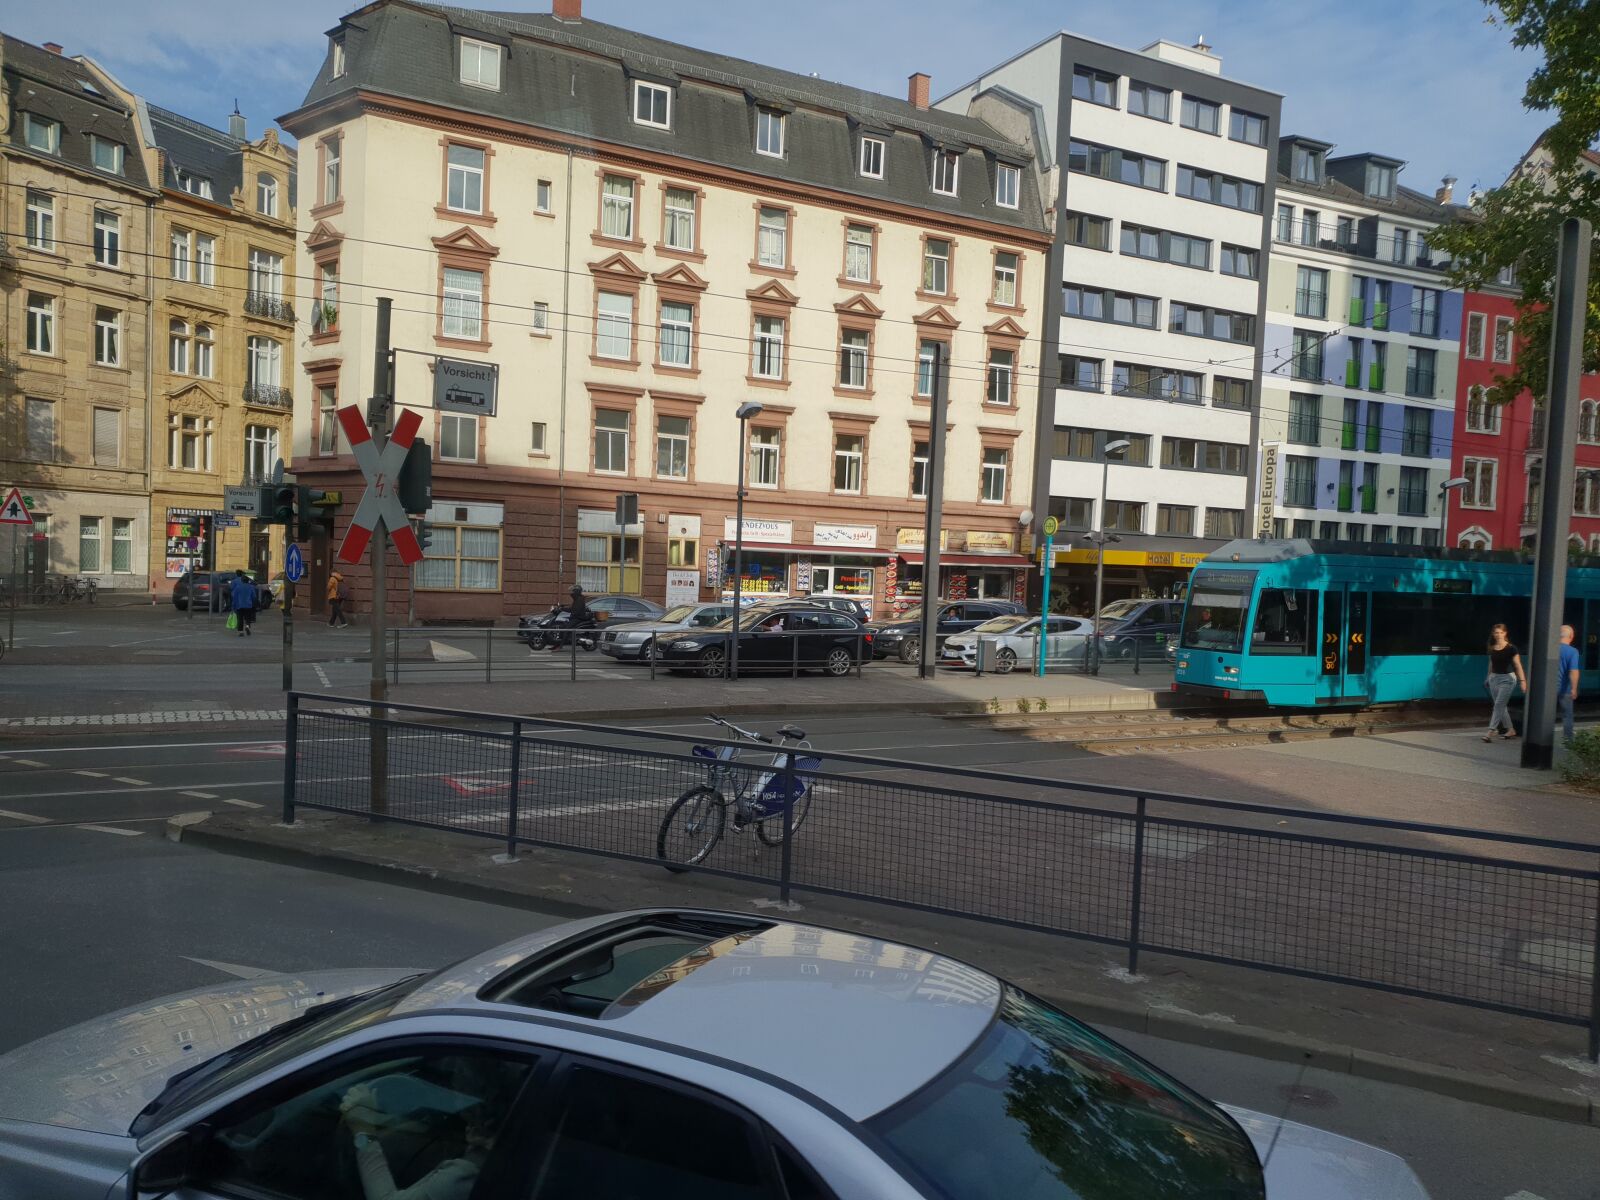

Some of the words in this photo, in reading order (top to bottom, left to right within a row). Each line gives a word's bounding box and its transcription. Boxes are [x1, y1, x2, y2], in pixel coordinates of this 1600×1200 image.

[1262, 448, 1277, 499] Europa
[740, 521, 779, 529] ENDEZVOUS
[1147, 553, 1172, 565] Hotel
[1180, 553, 1202, 565] Euro
